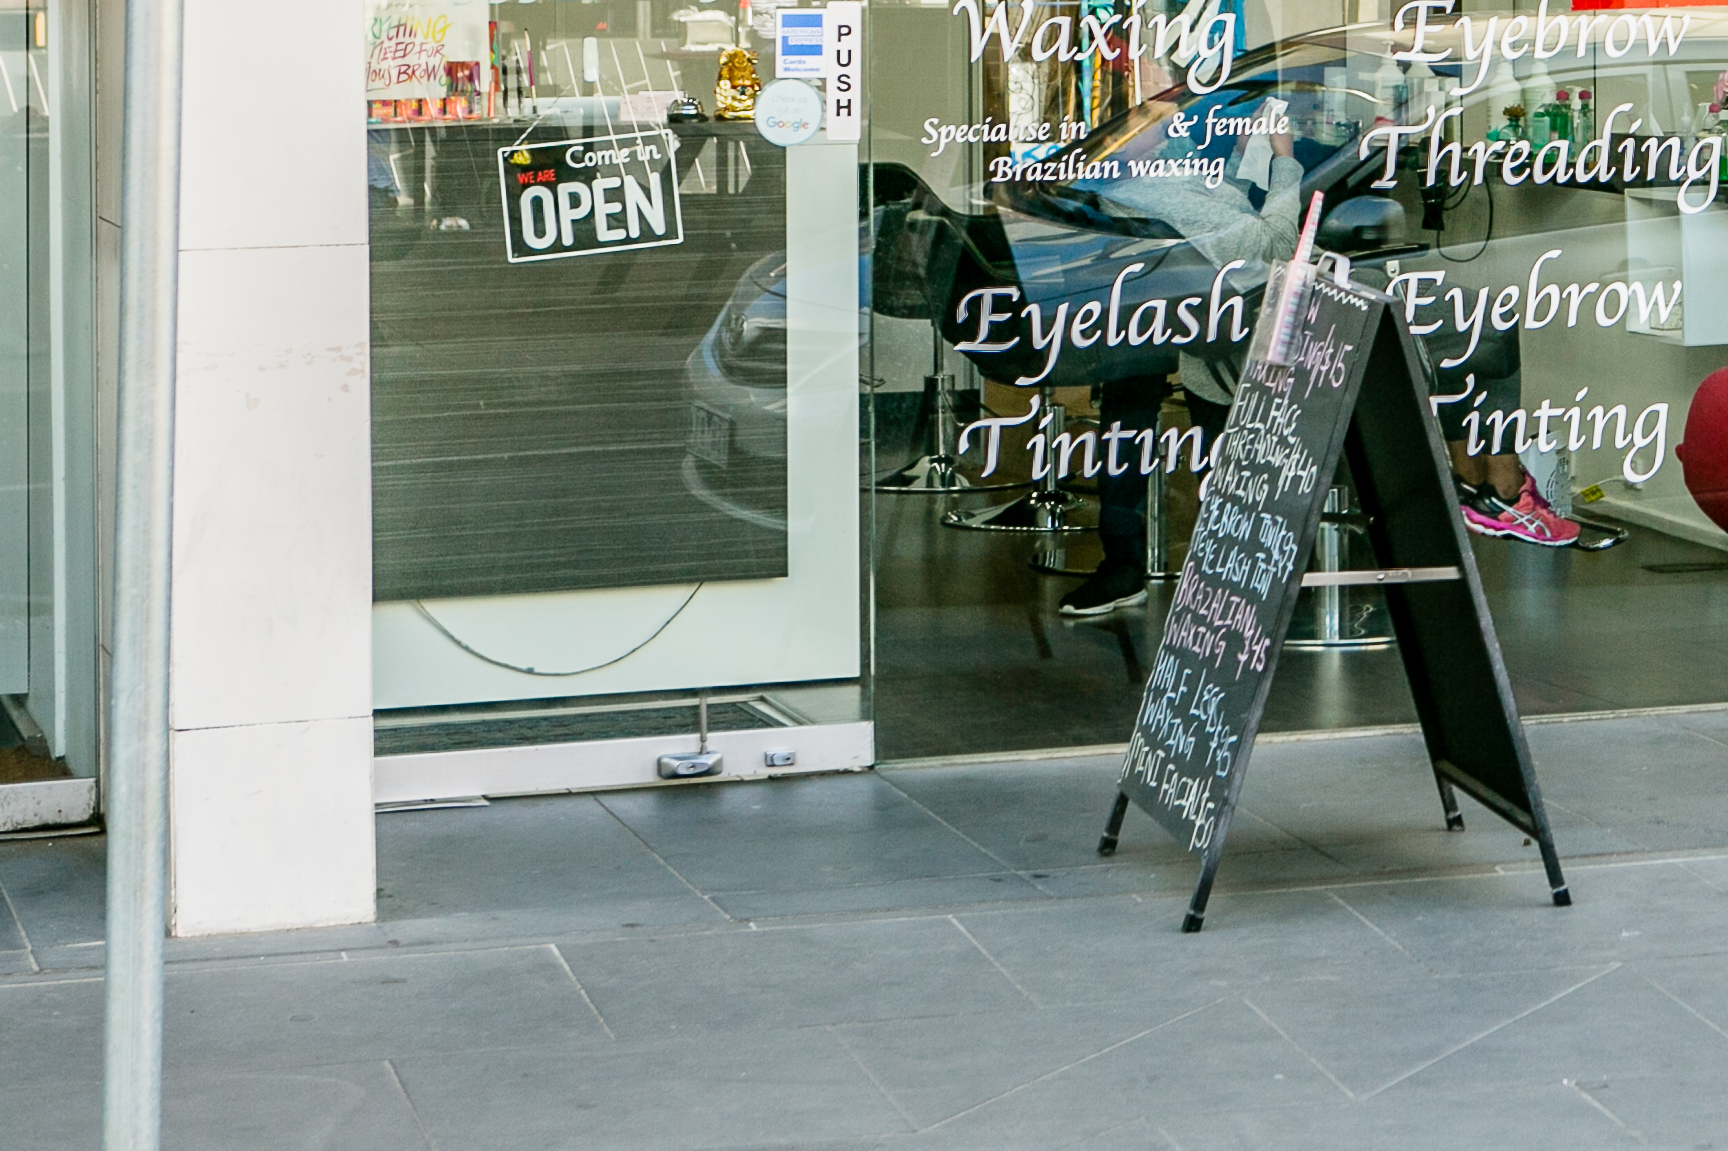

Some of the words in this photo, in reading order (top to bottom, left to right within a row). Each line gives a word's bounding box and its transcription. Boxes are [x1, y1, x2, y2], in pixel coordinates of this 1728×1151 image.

[835, 24, 852, 117] PUSH
[765, 116, 809, 132] Google
[1059, 116, 1087, 141] in
[1167, 111, 1198, 139] &
[1197, 104, 1290, 150] female
[517, 171, 535, 185] WE
[537, 169, 556, 183] ARE
[565, 145, 630, 169] Come
[636, 139, 662, 162] in
[989, 149, 1121, 183] Brazilian
[1128, 153, 1226, 189] waxing
[1358, 101, 1723, 215] Threading
[520, 171, 667, 250] OPEN
[952, 259, 1249, 386] Eyelash
[1386, 248, 1682, 368] Eyebrow
